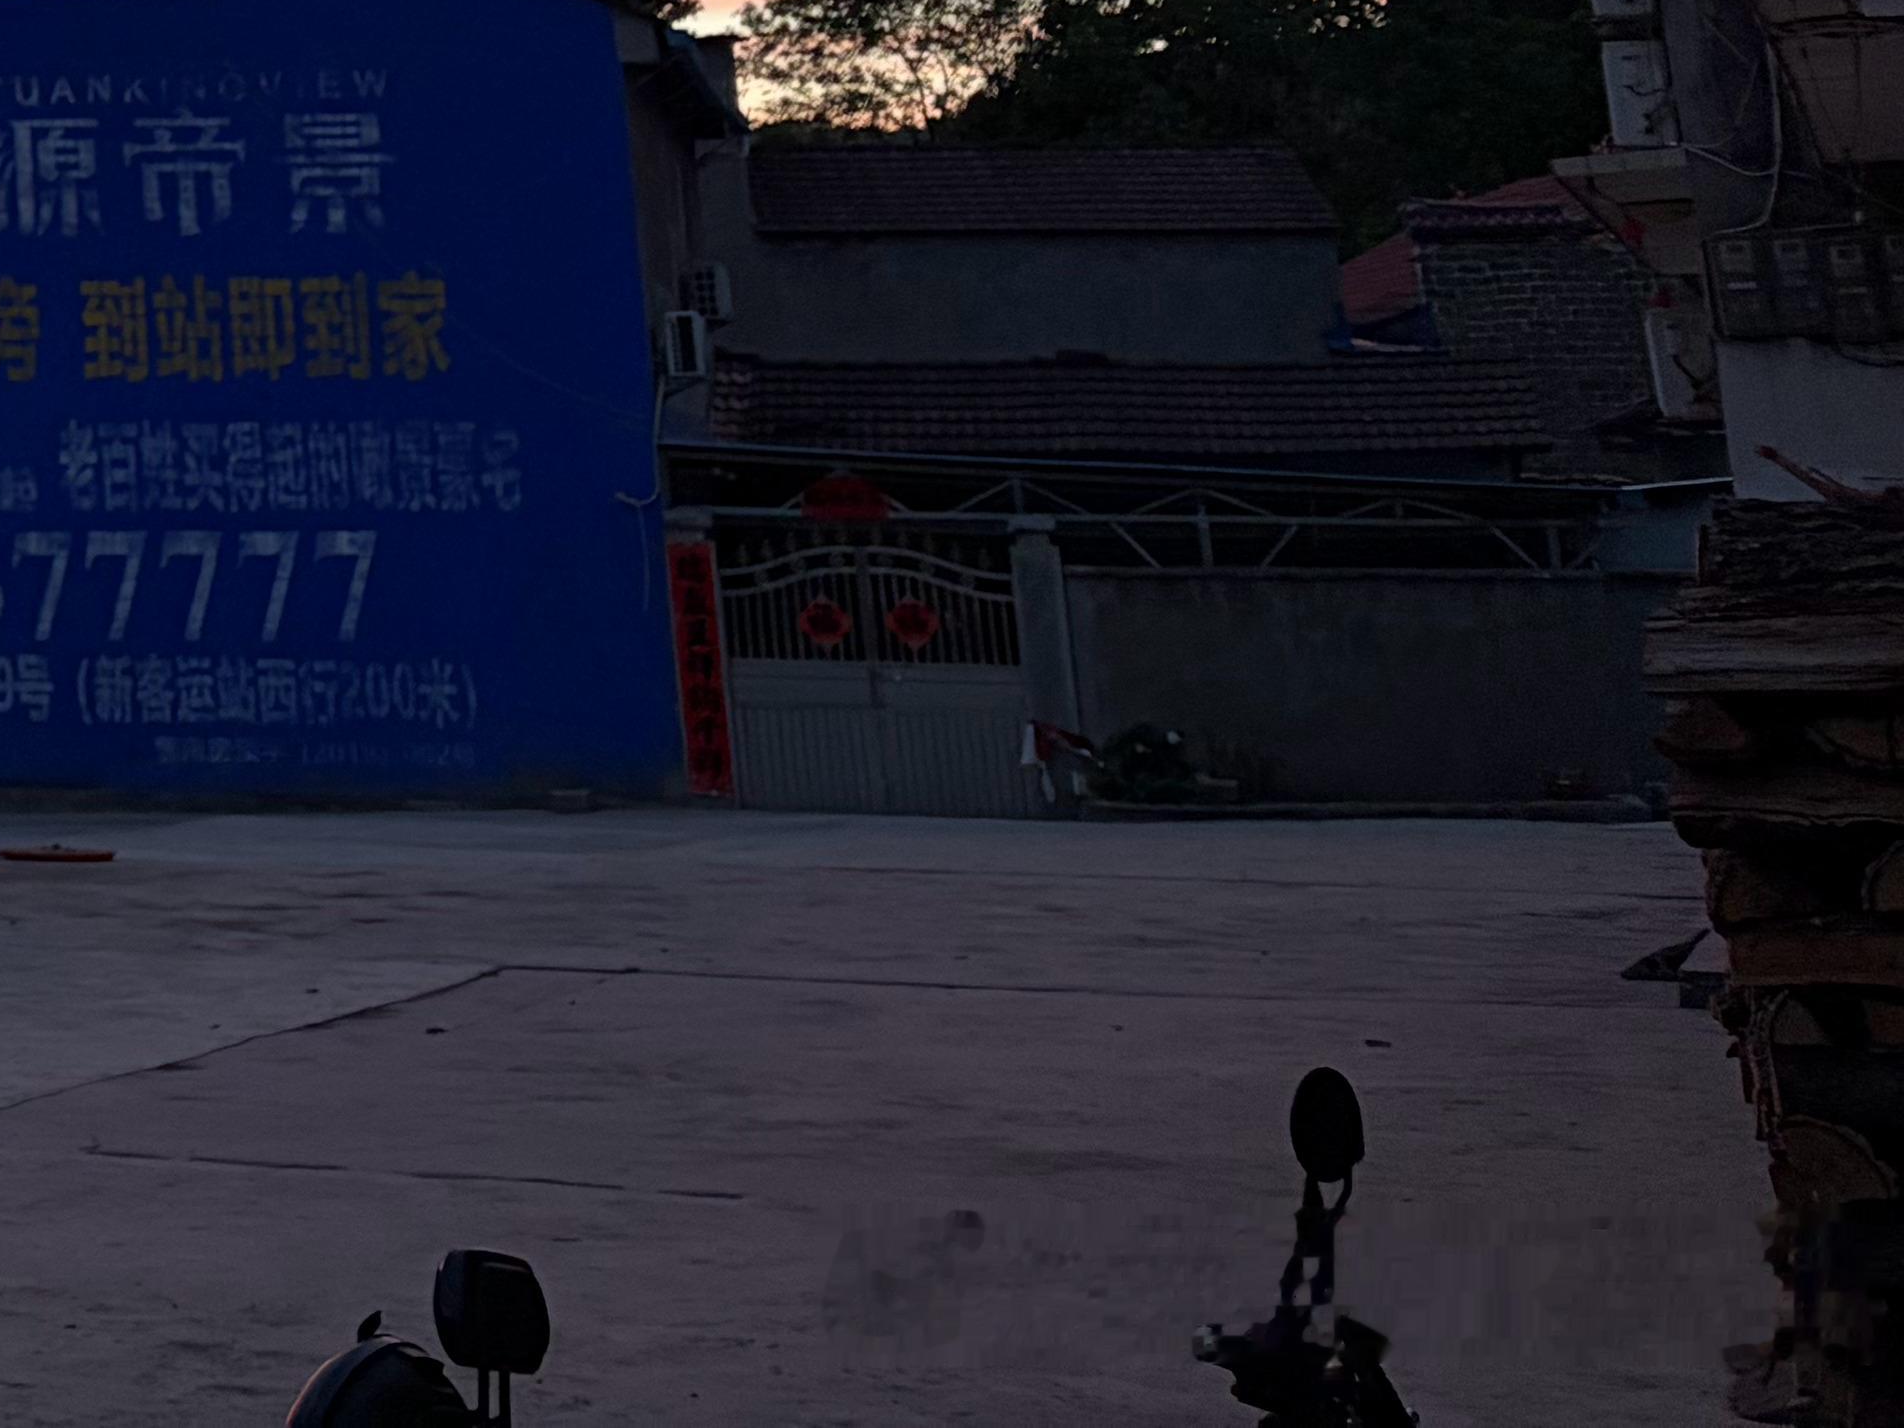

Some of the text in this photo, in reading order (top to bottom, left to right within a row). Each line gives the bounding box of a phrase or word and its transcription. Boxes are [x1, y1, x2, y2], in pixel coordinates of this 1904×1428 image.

[79, 270, 452, 384] 到站即到家
